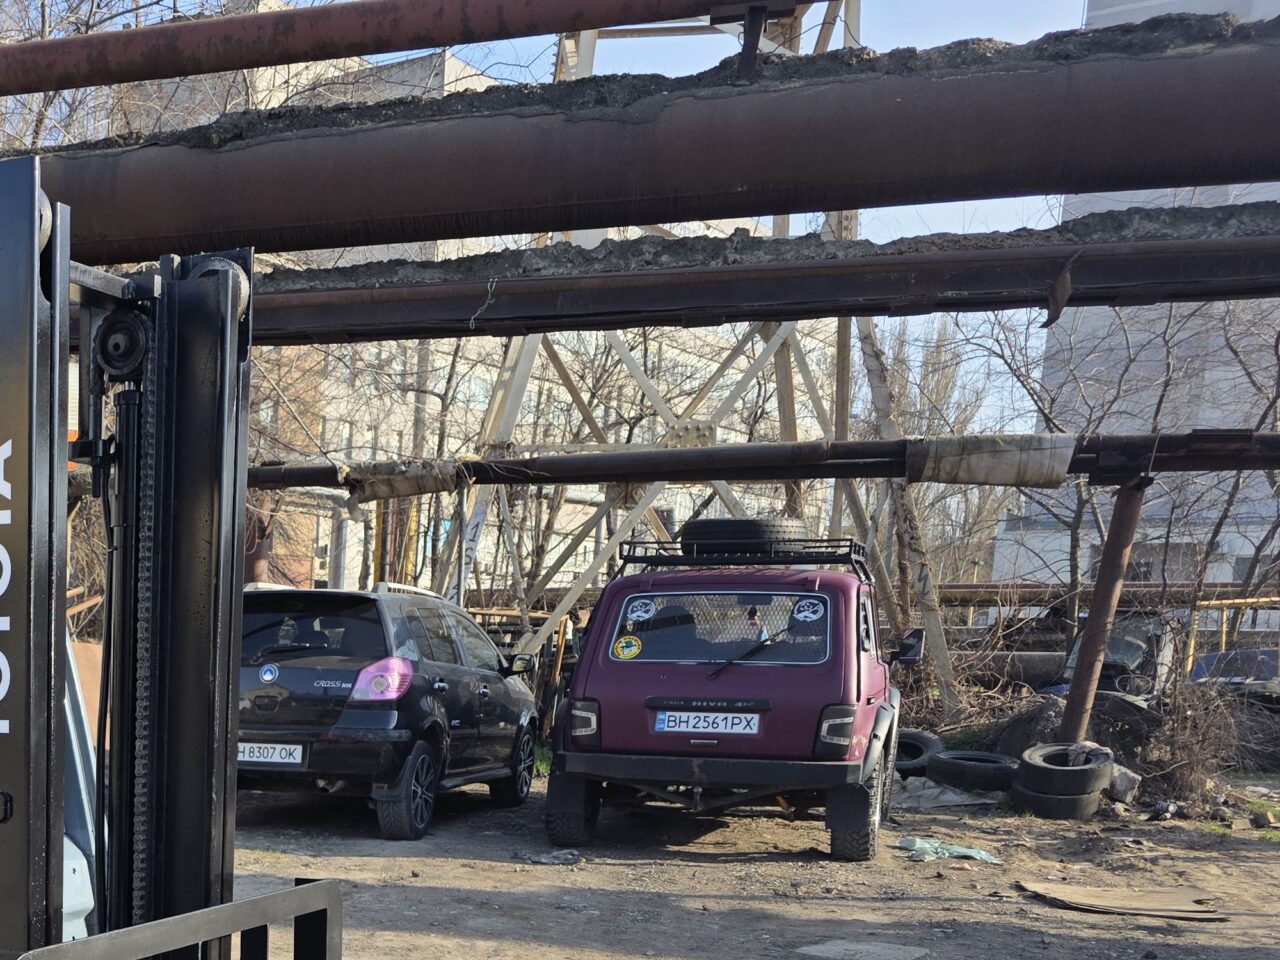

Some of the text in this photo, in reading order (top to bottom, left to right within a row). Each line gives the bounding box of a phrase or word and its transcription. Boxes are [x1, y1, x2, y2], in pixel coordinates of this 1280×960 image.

[314, 680, 341, 688] CROSS
[248, 746, 276, 759] 8307
[279, 747, 297, 760] OK
